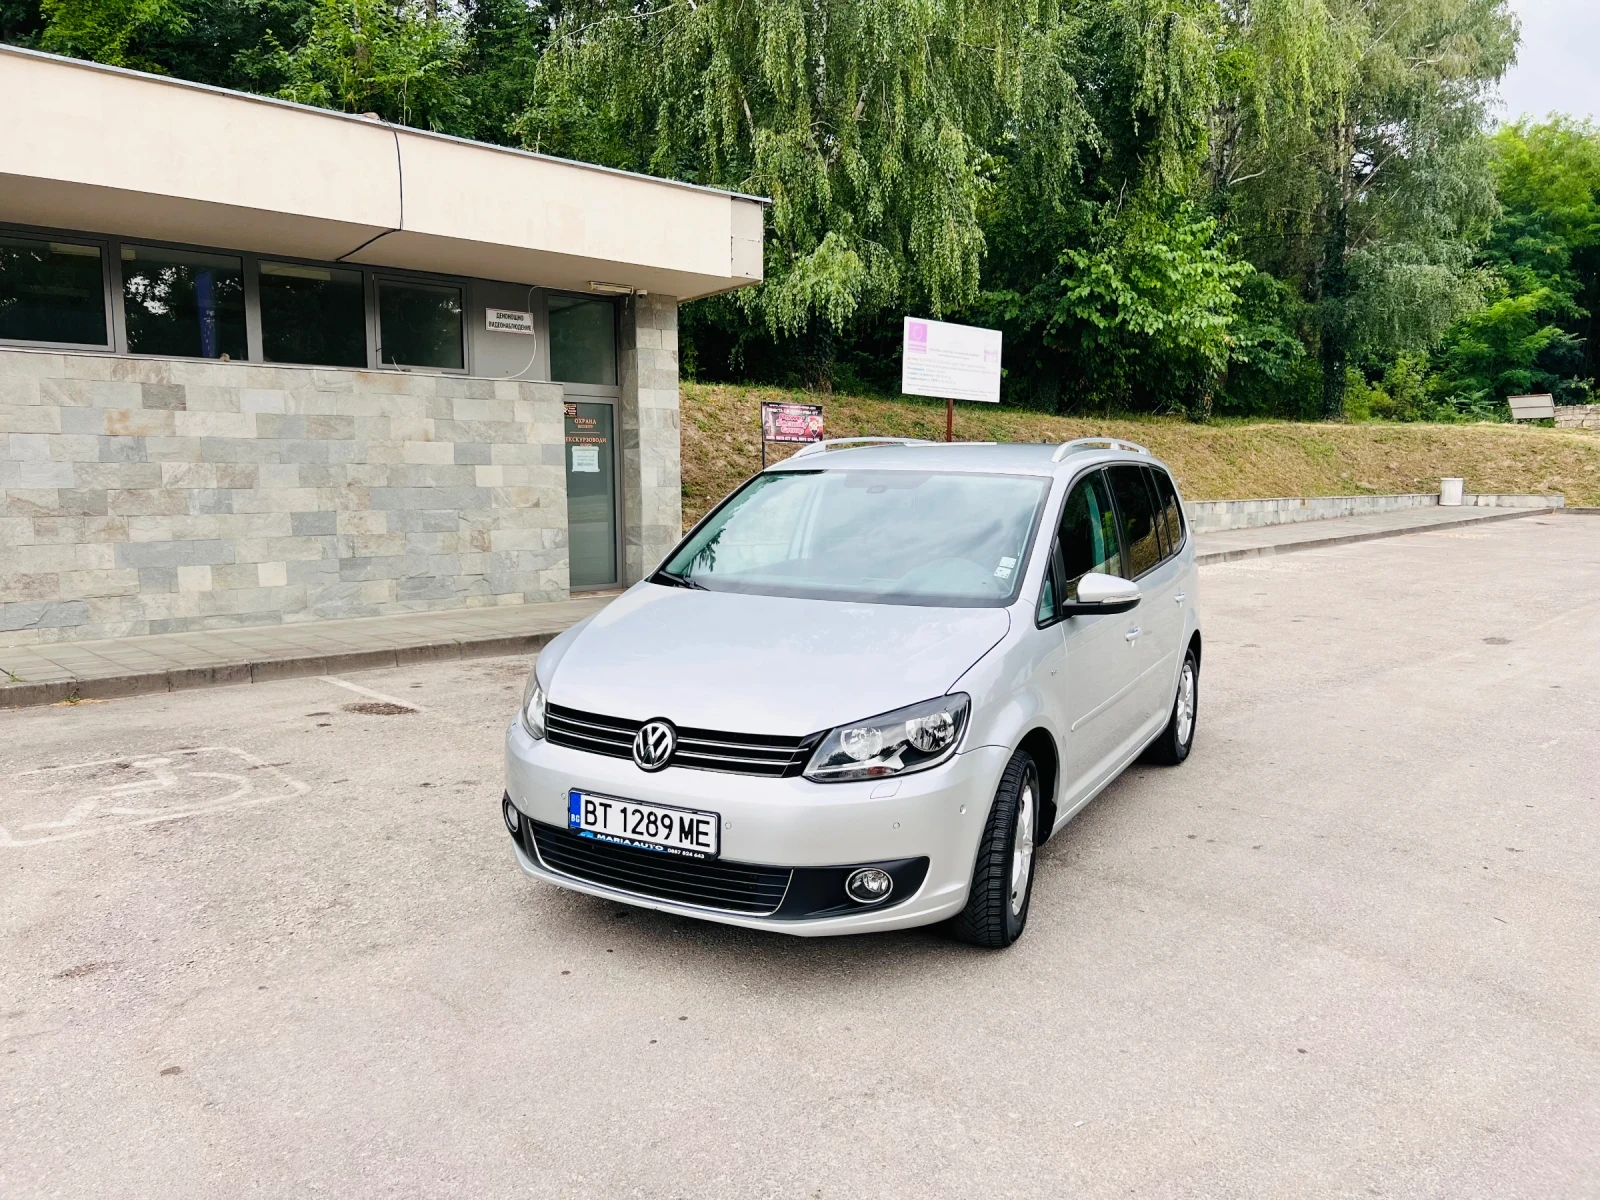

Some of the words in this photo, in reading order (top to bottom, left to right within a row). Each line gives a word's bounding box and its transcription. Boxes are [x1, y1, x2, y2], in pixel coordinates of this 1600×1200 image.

[496, 312, 524, 322] ДЕНОНОЩНО
[488, 320, 532, 332] ВИДЕОНАБЛЮДЕНИЕ
[565, 436, 607, 444] ЕКСКУРЗОВОДИ
[571, 814, 580, 822] BG
[584, 799, 612, 829] BT
[620, 806, 674, 840] 1289
[679, 816, 711, 848] ME
[597, 834, 631, 845] MARIA
[633, 842, 664, 851] AUTO
